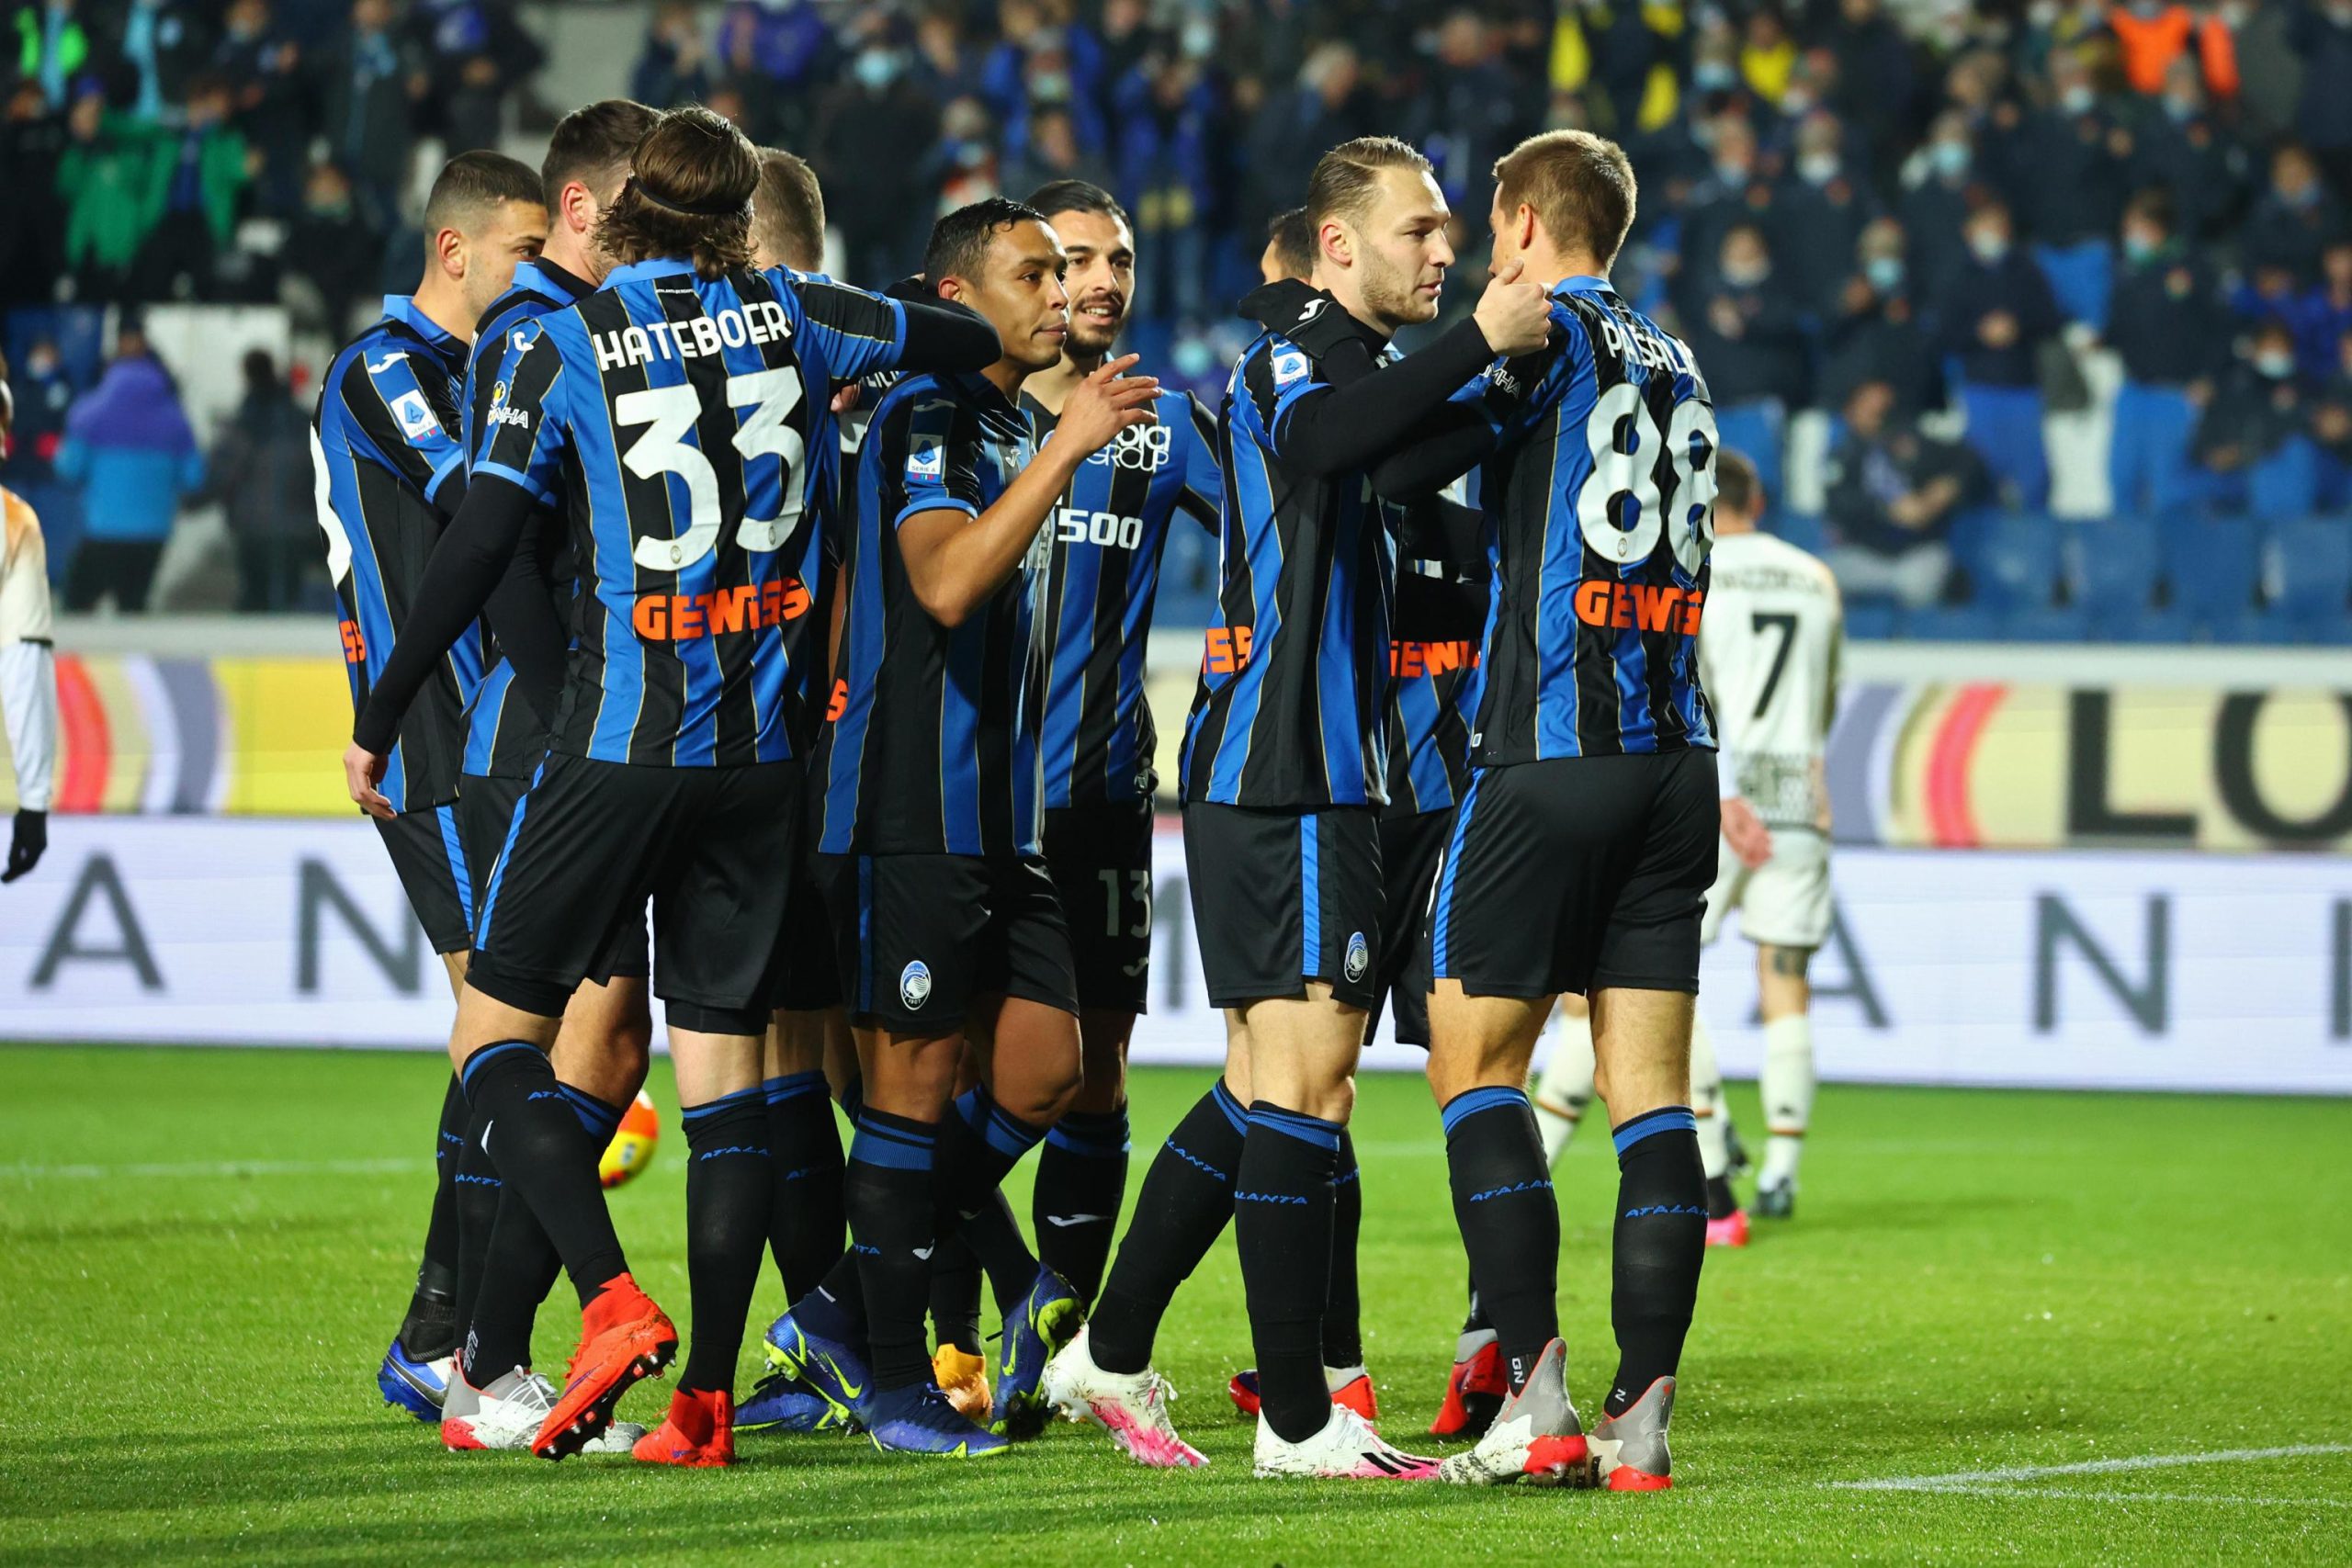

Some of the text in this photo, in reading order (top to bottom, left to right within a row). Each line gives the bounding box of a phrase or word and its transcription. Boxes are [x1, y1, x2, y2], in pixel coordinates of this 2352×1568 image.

[593, 300, 792, 372] HATEBOER
[616, 366, 807, 571] 33
[1577, 383, 1720, 581] 88
[1057, 508, 1144, 551] 500
[632, 577, 809, 641] GEWISS
[1751, 612, 1798, 719] 7
[1098, 870, 1151, 939] 13
